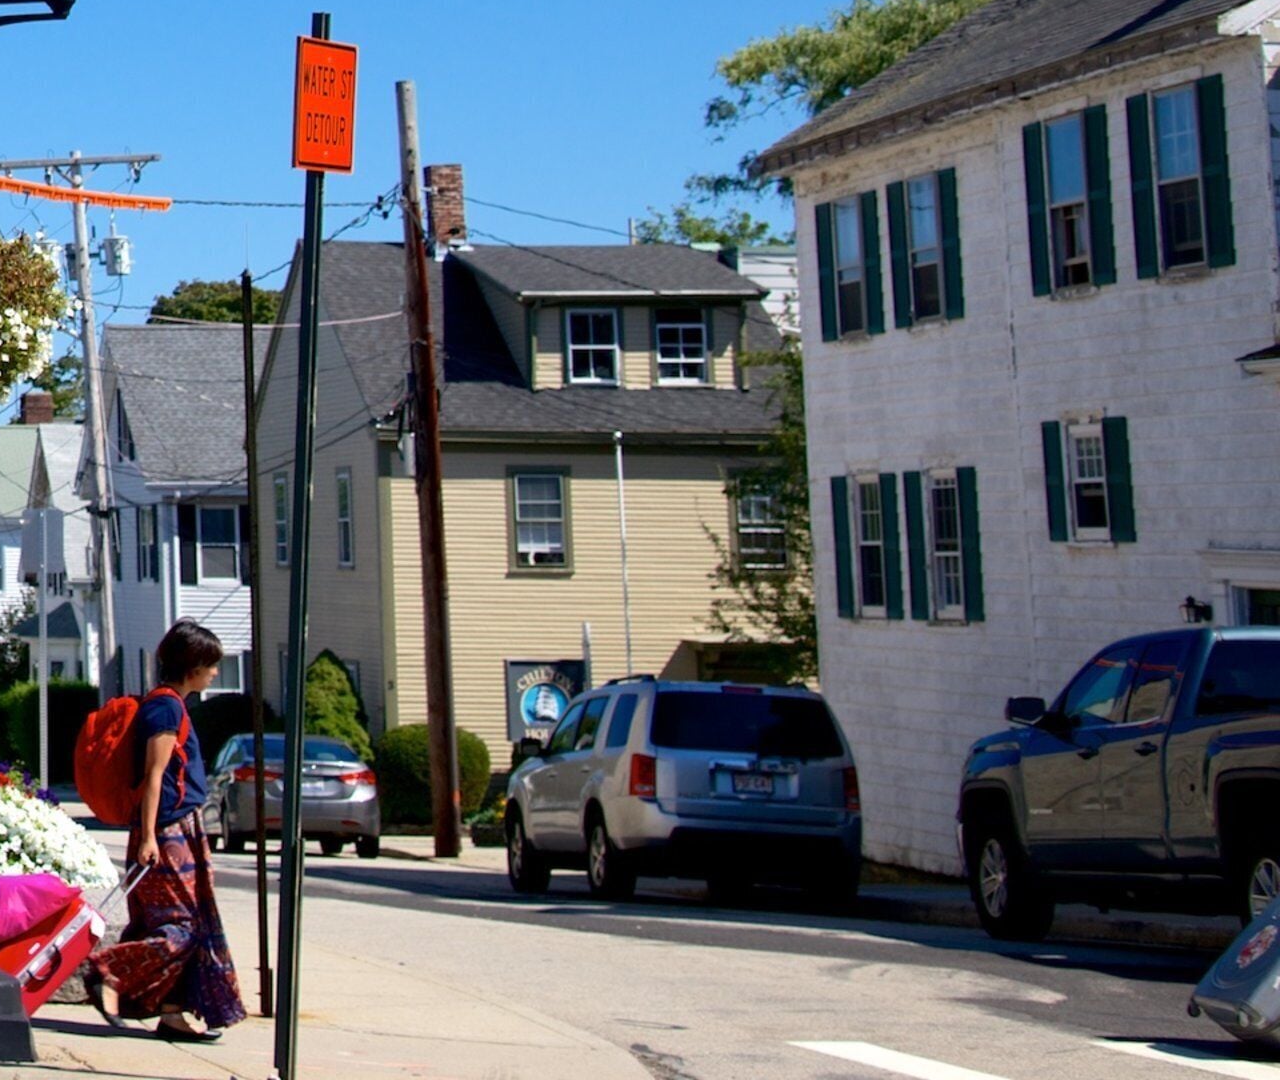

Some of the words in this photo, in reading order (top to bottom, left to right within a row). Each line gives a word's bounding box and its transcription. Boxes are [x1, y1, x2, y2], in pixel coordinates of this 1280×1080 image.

[303, 64, 336, 98] WATER
[341, 70, 353, 100] ST
[306, 113, 346, 146] DETOUR
[517, 665, 573, 691] CHILTON
